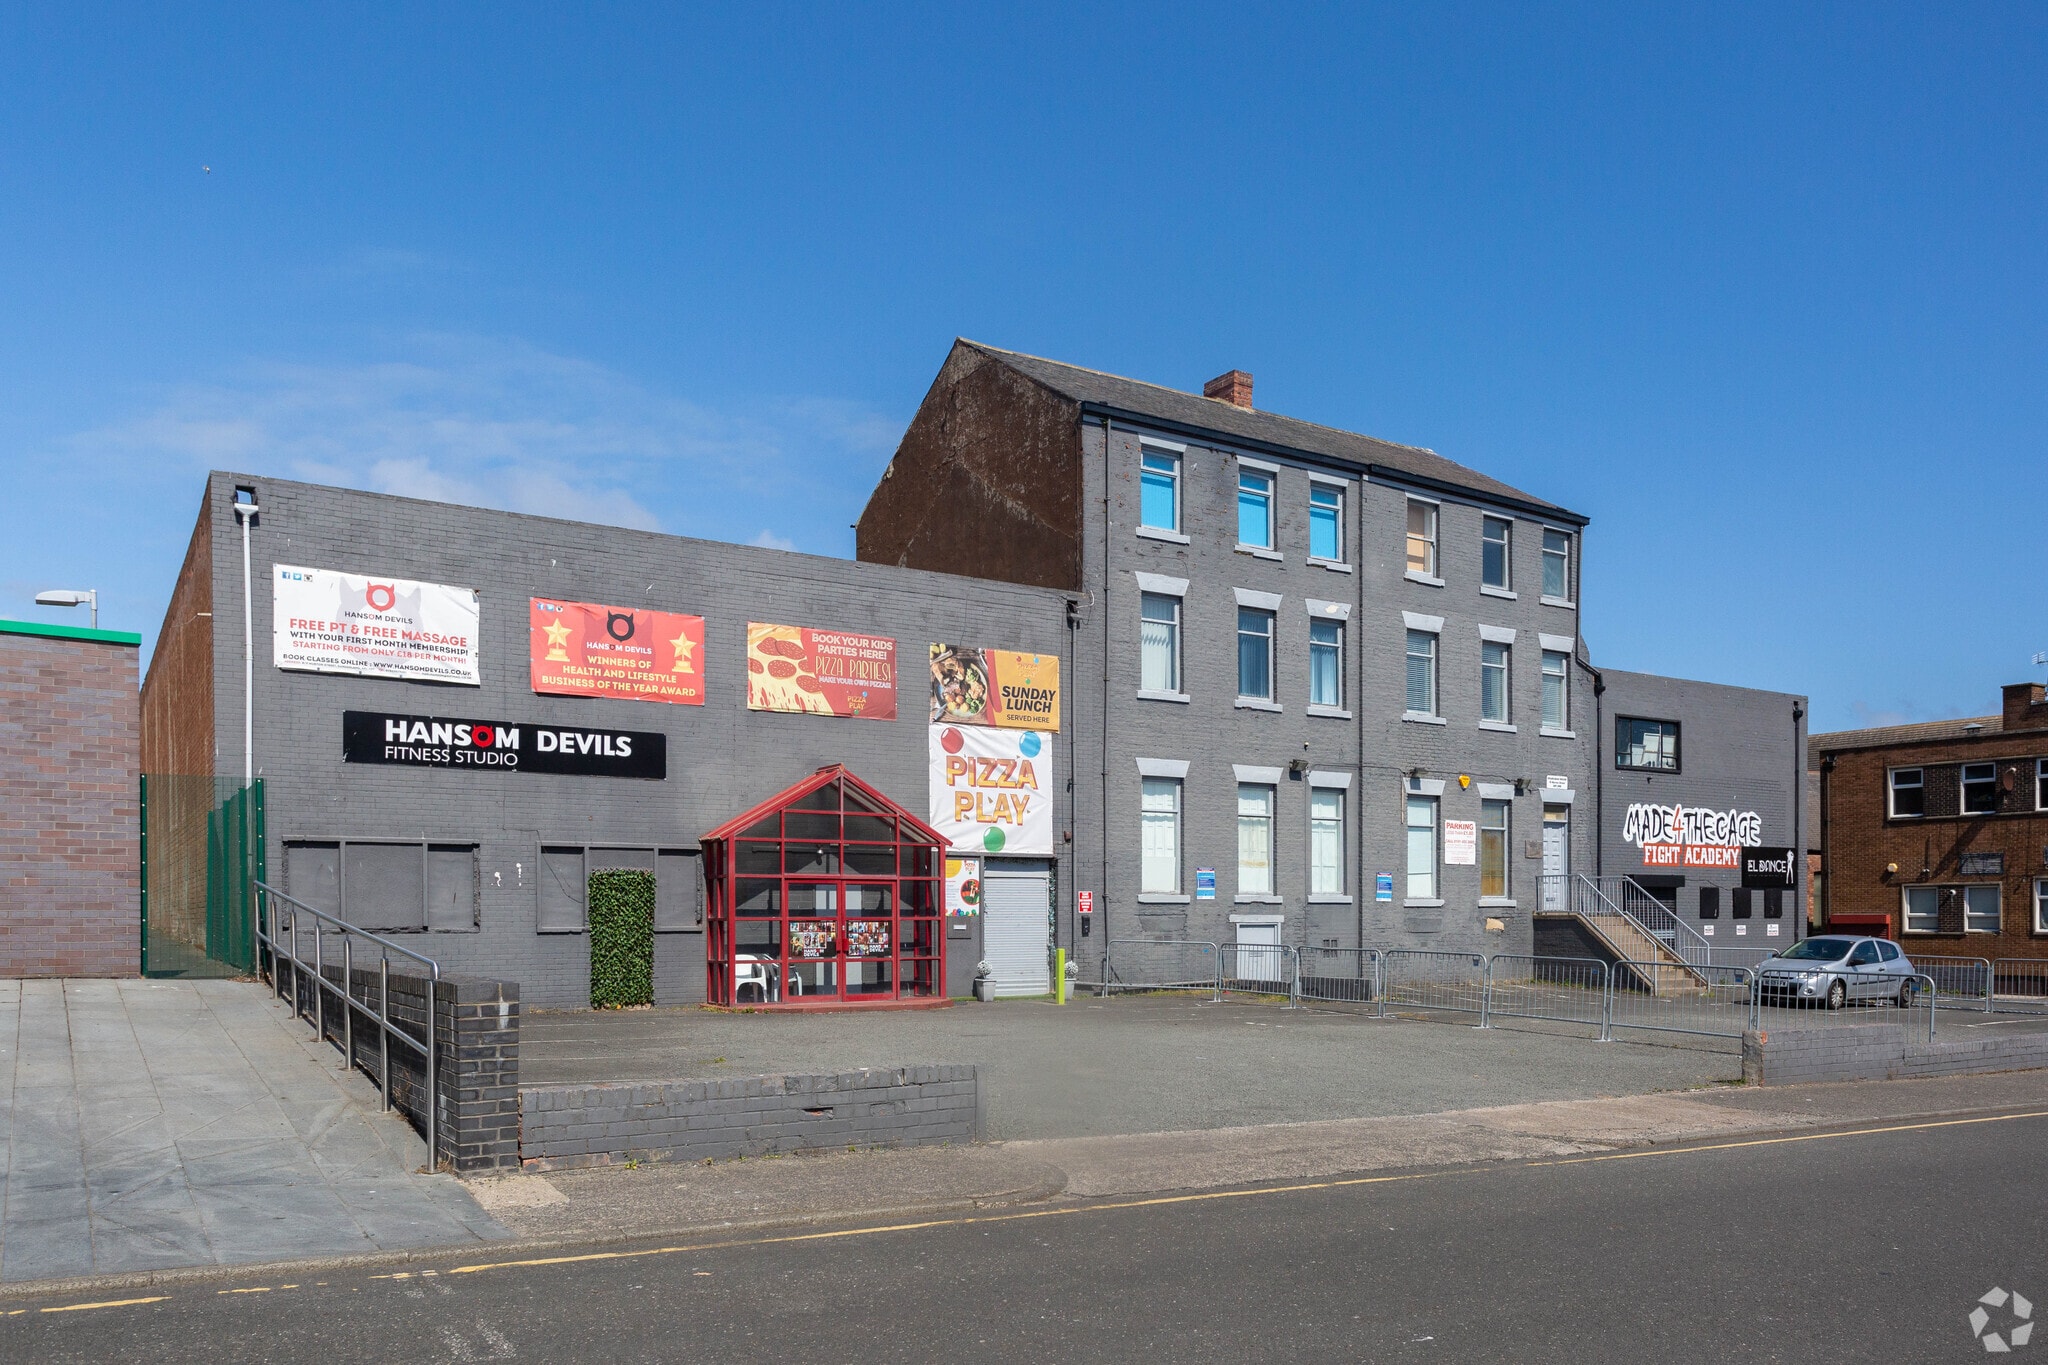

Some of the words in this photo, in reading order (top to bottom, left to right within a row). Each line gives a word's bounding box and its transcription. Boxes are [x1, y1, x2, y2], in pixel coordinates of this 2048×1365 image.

[344, 611, 382, 622] HANSOM
[385, 615, 413, 625] DEVILS
[290, 618, 325, 632] FREE
[330, 622, 347, 633] PT
[351, 624, 360, 634] &
[364, 626, 398, 638] FREE
[402, 629, 467, 647] MASSAGE
[290, 630, 316, 640] WITH
[318, 632, 344, 642] YOUR
[346, 636, 372, 645] FIRST
[374, 638, 407, 649] MONTH
[410, 642, 468, 656] MEMBERSHIP!
[586, 642, 623, 652] HANSOM
[624, 646, 652, 654] DEVILS
[812, 633, 841, 644] BOOK
[841, 636, 870, 648] YOUR
[871, 640, 893, 650] KIDS
[292, 640, 340, 652] STARTING
[343, 644, 369, 654] FROM
[371, 647, 394, 656] ONLY
[397, 650, 412, 658] £18
[414, 652, 431, 660] PER
[434, 654, 466, 664] MONTH!
[818, 644, 858, 657] PARTIES
[859, 649, 887, 660] HERE!
[306, 656, 339, 664] CLASSES
[340, 658, 368, 666] ONLINE
[587, 655, 636, 668] WINNERS
[638, 660, 652, 670] OF
[815, 656, 844, 676] PIZZA
[849, 660, 892, 682] PARTIES!
[562, 666, 601, 677] HEALTH
[603, 669, 626, 679] AND
[628, 671, 677, 684] LIFESTYLE
[818, 676, 836, 684] MAKE
[836, 677, 854, 686] YOUR
[854, 679, 868, 687] OWN
[542, 675, 595, 688] BUSINESS
[597, 680, 610, 689] OF
[612, 682, 631, 691] THE
[632, 684, 659, 694] YEAR
[660, 686, 696, 697] AWARD
[1002, 686, 1056, 702] SUNDAY
[848, 696, 866, 704] PIZZA
[848, 702, 864, 710] PLAY
[1006, 698, 1052, 713] LUNCH
[1006, 714, 1032, 722] SERVED
[1033, 716, 1050, 724] HERE
[385, 719, 520, 750] HANSOM
[537, 730, 632, 758] DEVILS
[385, 746, 450, 763] FITNESS
[455, 750, 518, 766] STUDIO
[946, 755, 1038, 790] PIZZA
[954, 790, 1031, 826] PLAY
[1446, 822, 1474, 830] PARKING
[1644, 846, 1681, 864] FIGHT
[1684, 846, 1740, 866] ACADEMY
[1748, 860, 1758, 872] EL
